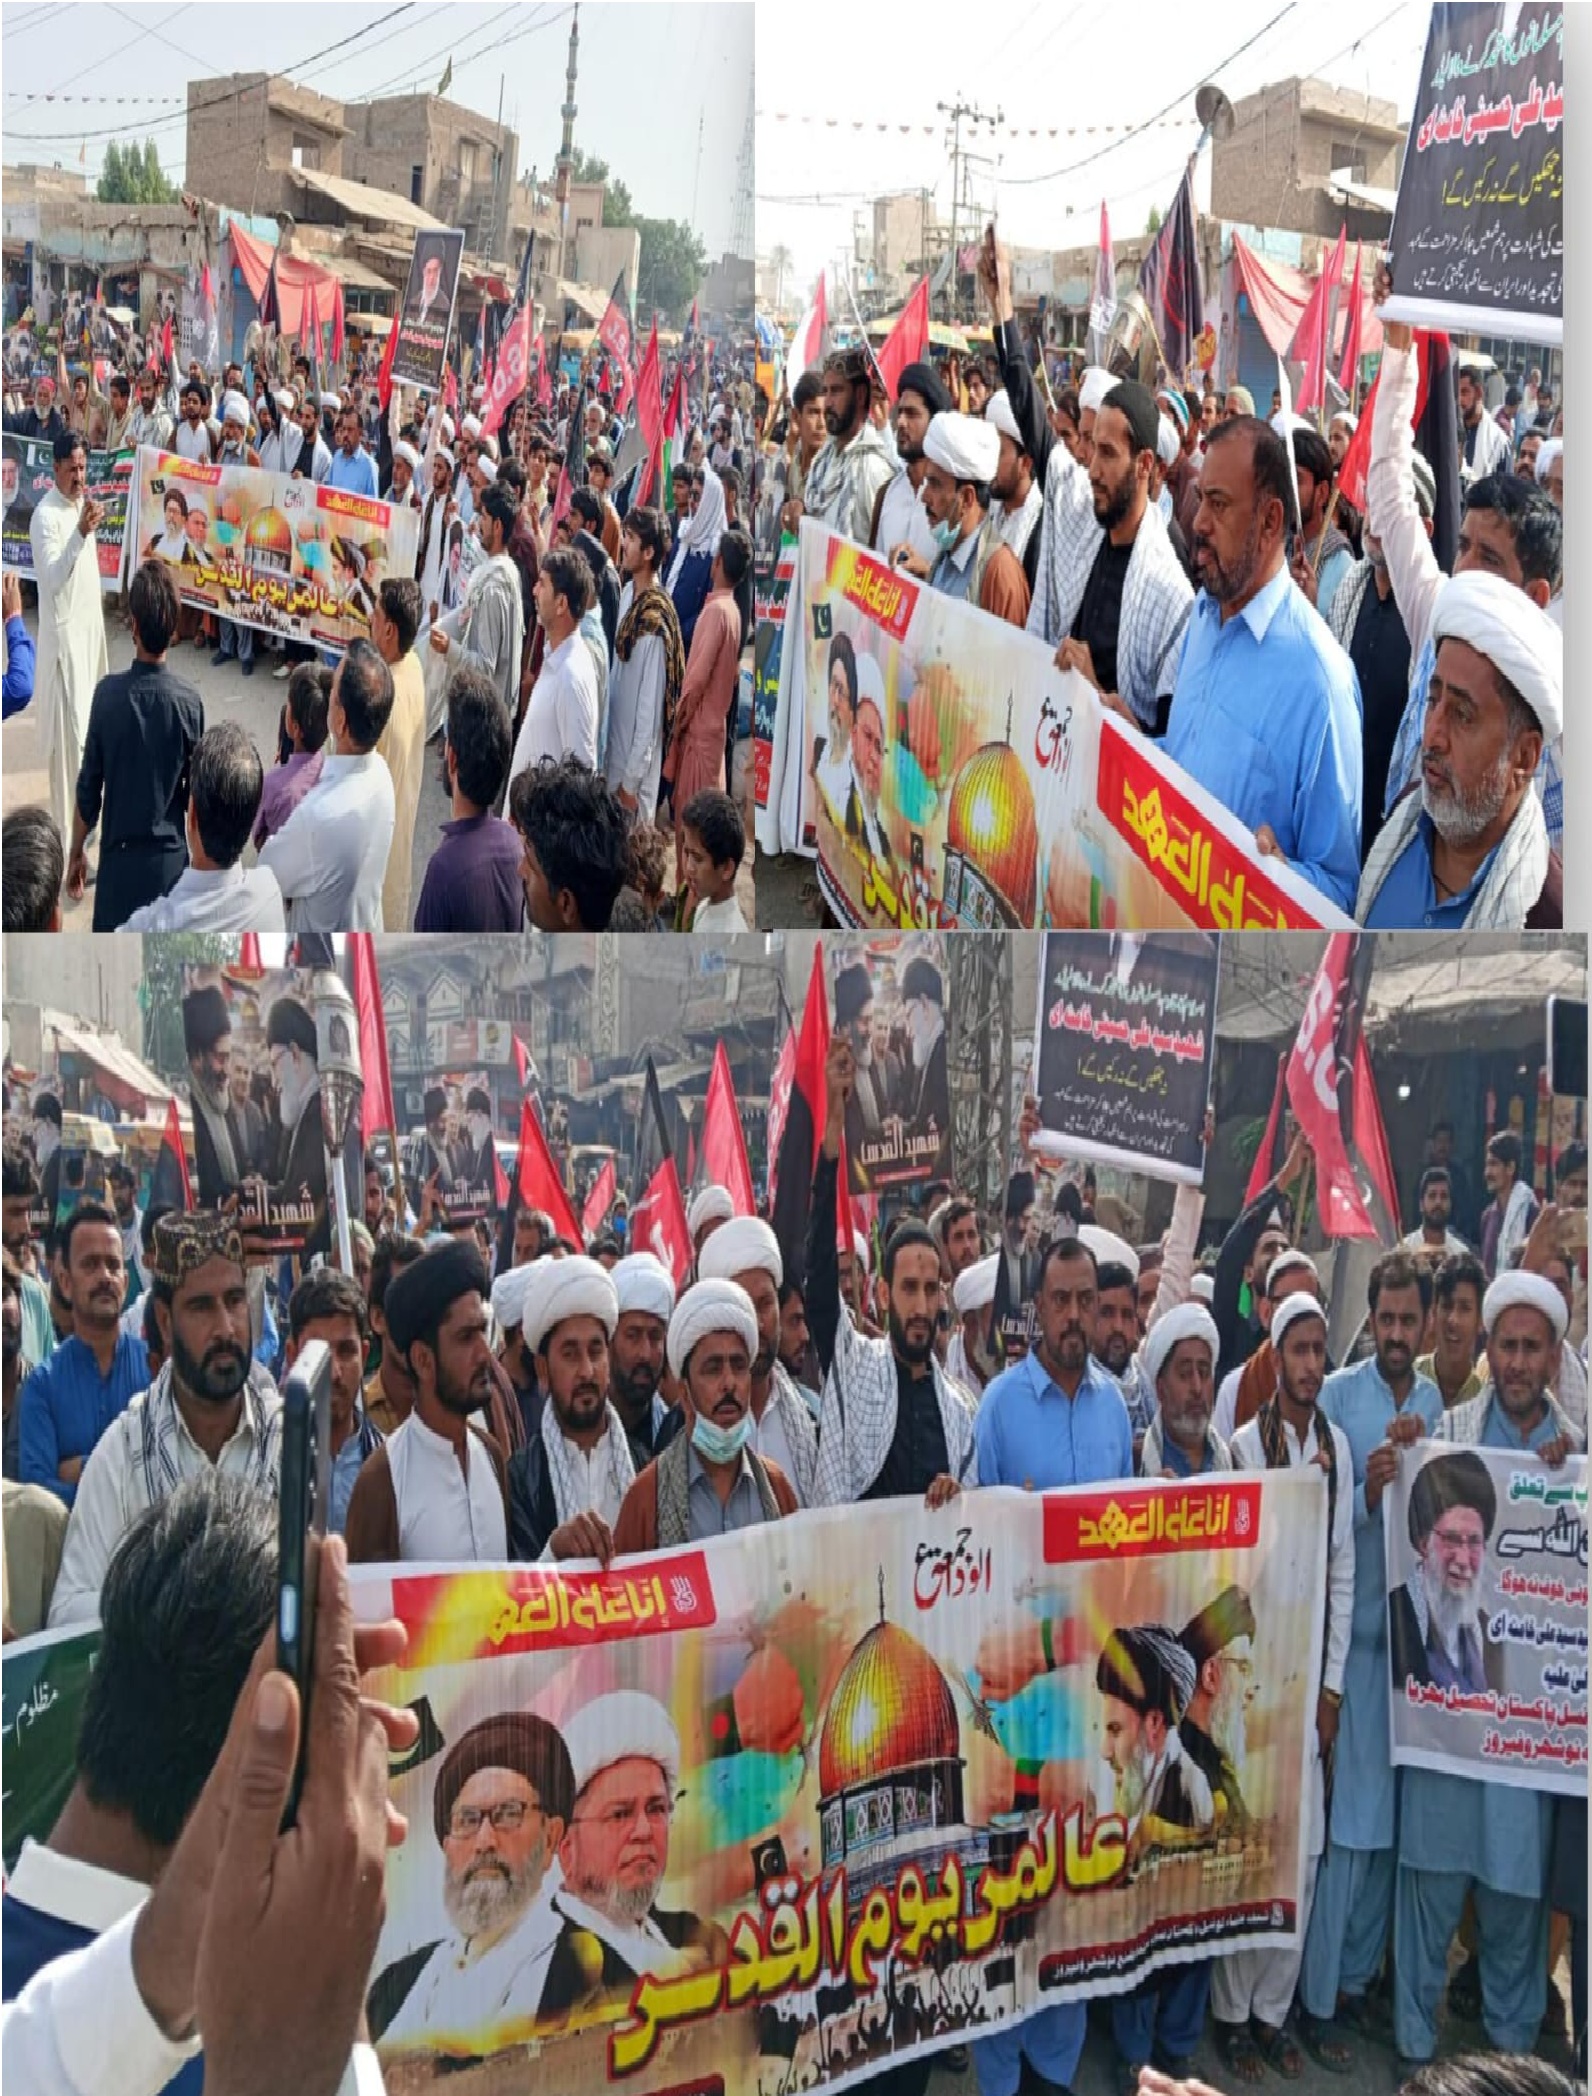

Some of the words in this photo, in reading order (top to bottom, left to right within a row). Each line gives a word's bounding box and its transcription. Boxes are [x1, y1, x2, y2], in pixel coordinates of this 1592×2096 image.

[1512, 75, 1543, 140] علی
[1542, 81, 1563, 132] ید
[1510, 1475, 1546, 1500] تعلق
[1544, 1486, 1574, 1505] سے
[1078, 1497, 1164, 1549] العهد
[1496, 1525, 1546, 1559] سے
[1490, 1613, 1507, 1638] ای
[1536, 1622, 1556, 1645] علی
[1556, 1627, 1577, 1650] سید
[16, 1681, 60, 1749] مظلوم
[1444, 1684, 1497, 1714] تحصیل
[1496, 1694, 1557, 1731] پاکستان
[1557, 1701, 1588, 1728] نسل
[959, 1802, 1131, 1958] عالمی
[849, 1852, 967, 1992] یوم
[607, 1864, 849, 2081] القدس
